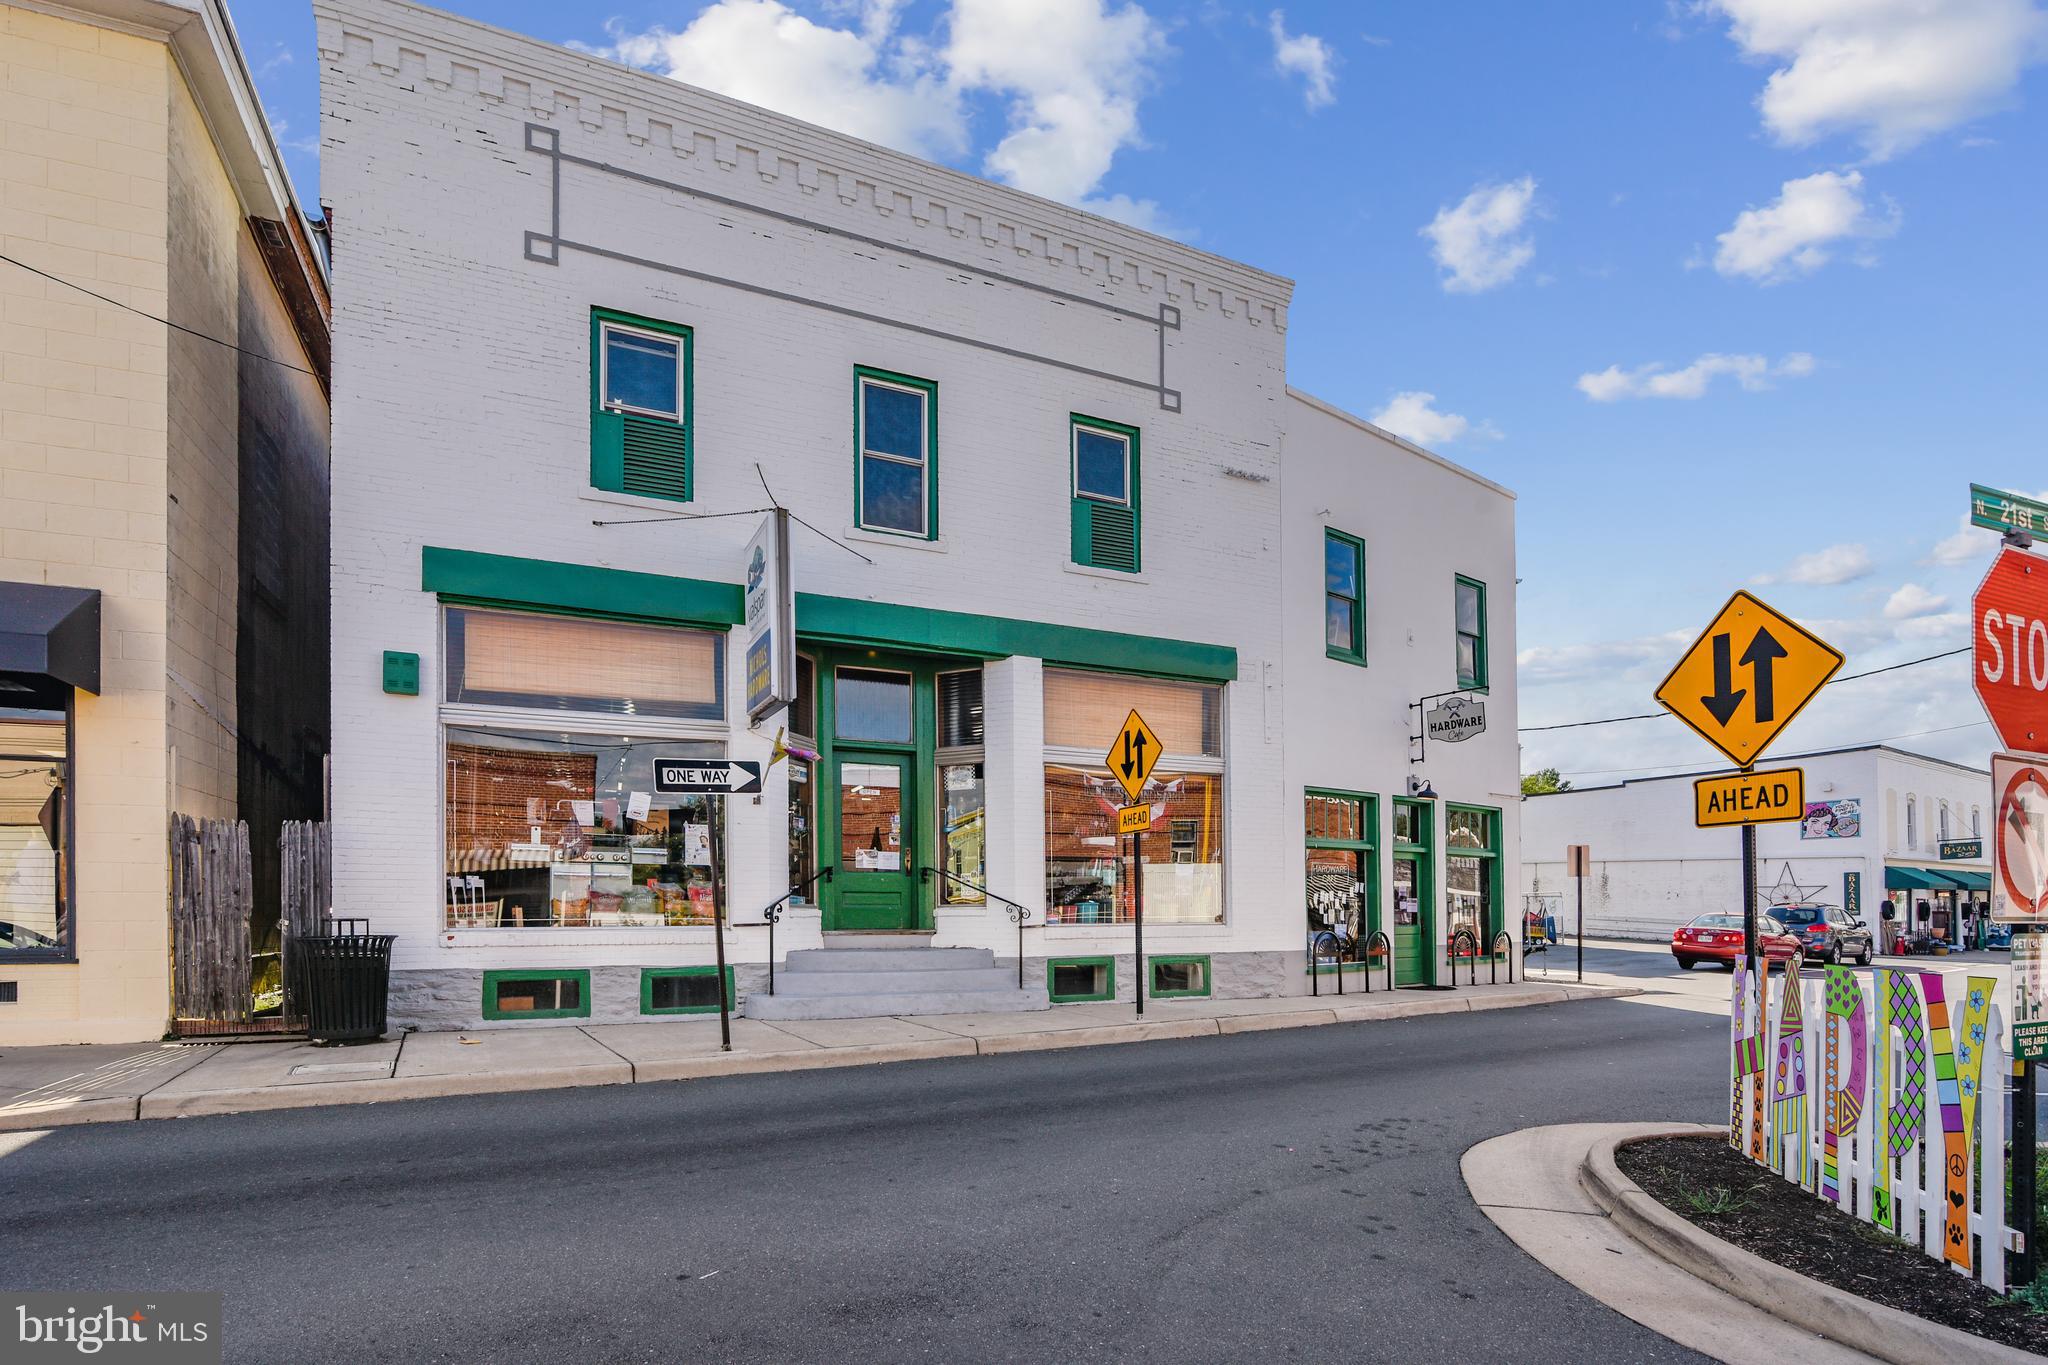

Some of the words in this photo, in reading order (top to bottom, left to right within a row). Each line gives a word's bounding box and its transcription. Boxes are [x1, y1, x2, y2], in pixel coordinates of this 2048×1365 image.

[1976, 499, 1988, 516] N.
[2000, 499, 2033, 530] 21st
[1982, 608, 2048, 692] STO
[1430, 716, 1482, 732] HARDWARE
[666, 769, 696, 782] ONE
[700, 770, 729, 783] WAY
[1708, 784, 1789, 813] AHEAD
[1123, 811, 1147, 827] AHEAD
[1944, 845, 1978, 855] BAZAAR
[1313, 864, 1348, 873] HARDWARE
[2013, 939, 2027, 949] PET
[2015, 1026, 2036, 1037] PLEASE
[2019, 1037, 2032, 1047] THIS
